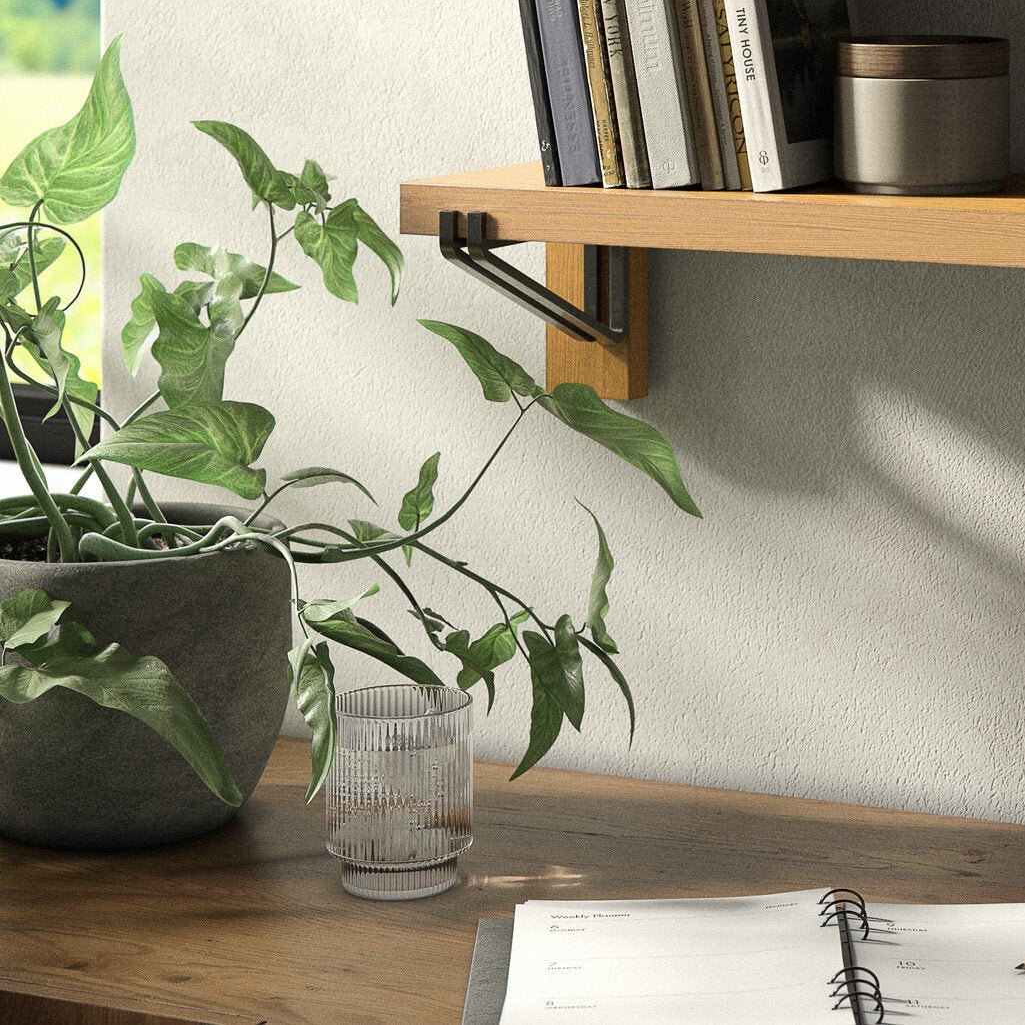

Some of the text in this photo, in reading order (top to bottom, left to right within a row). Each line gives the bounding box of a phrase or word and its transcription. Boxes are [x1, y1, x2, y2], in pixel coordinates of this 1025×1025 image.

[603, 12, 624, 59] YORK
[735, 7, 756, 82] TINY HOUSE
[716, 9, 747, 154] SATYRICON
